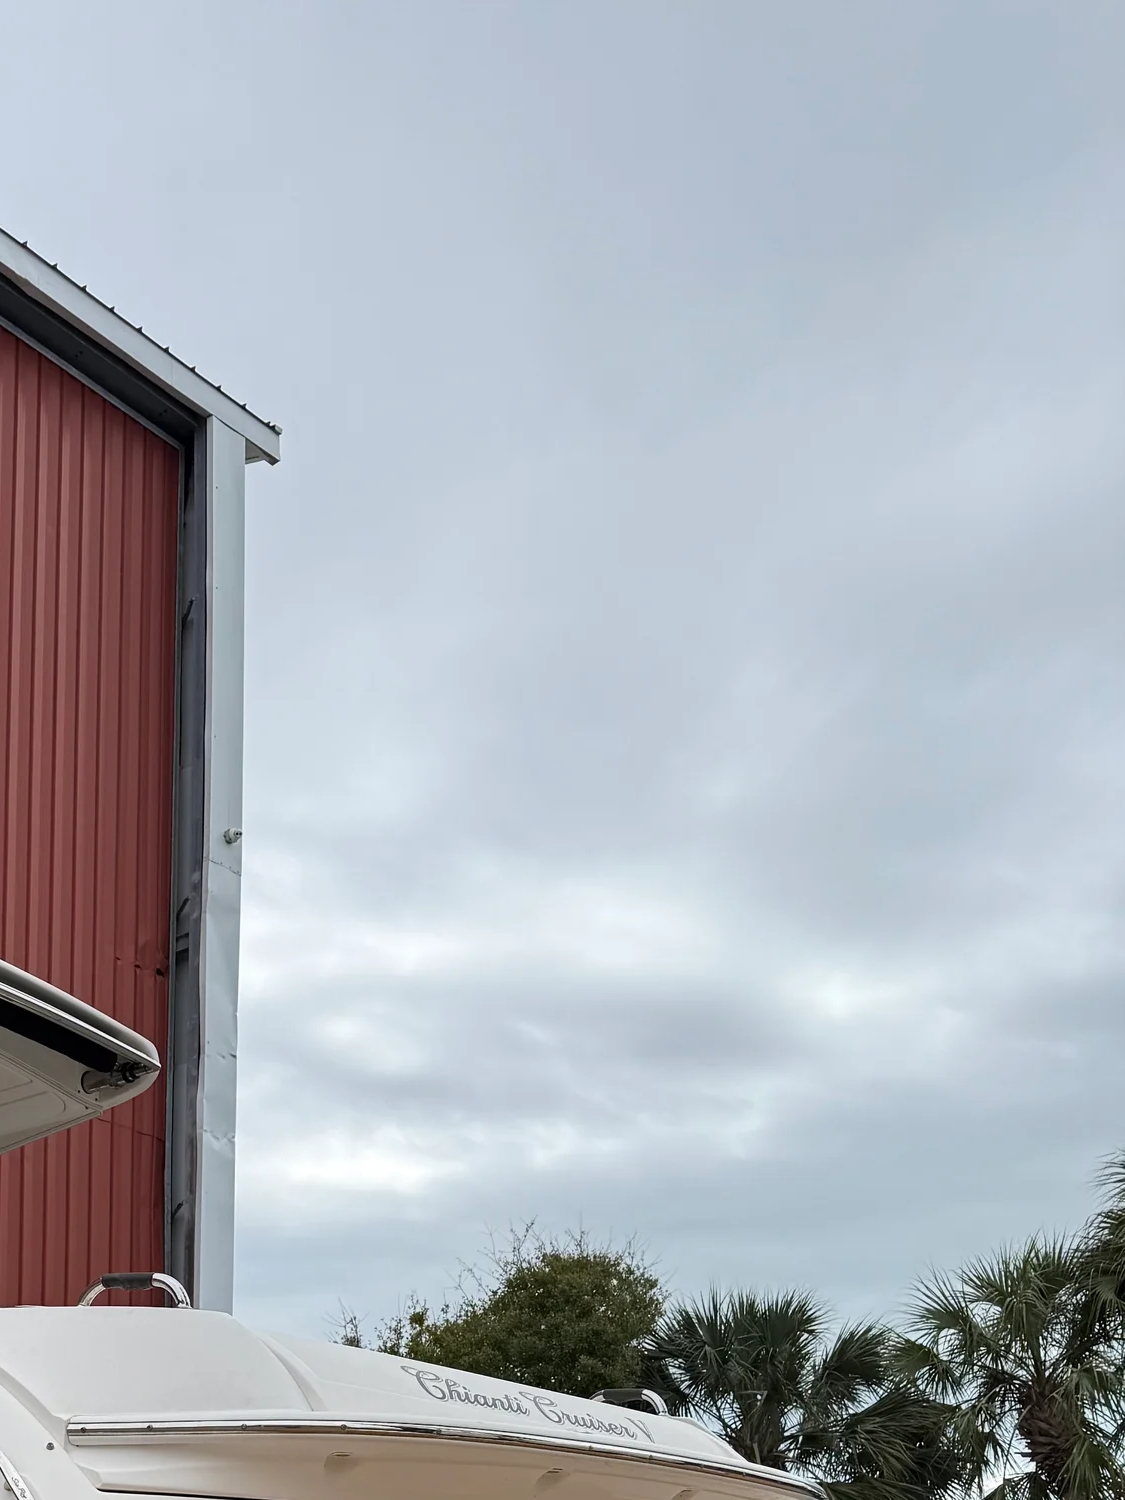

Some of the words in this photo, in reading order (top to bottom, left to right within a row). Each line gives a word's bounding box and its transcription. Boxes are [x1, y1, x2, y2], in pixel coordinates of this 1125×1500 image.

[400, 1365, 530, 1417] Chianti
[519, 1391, 638, 1440] Cruiser
[624, 1417, 655, 1444] V
